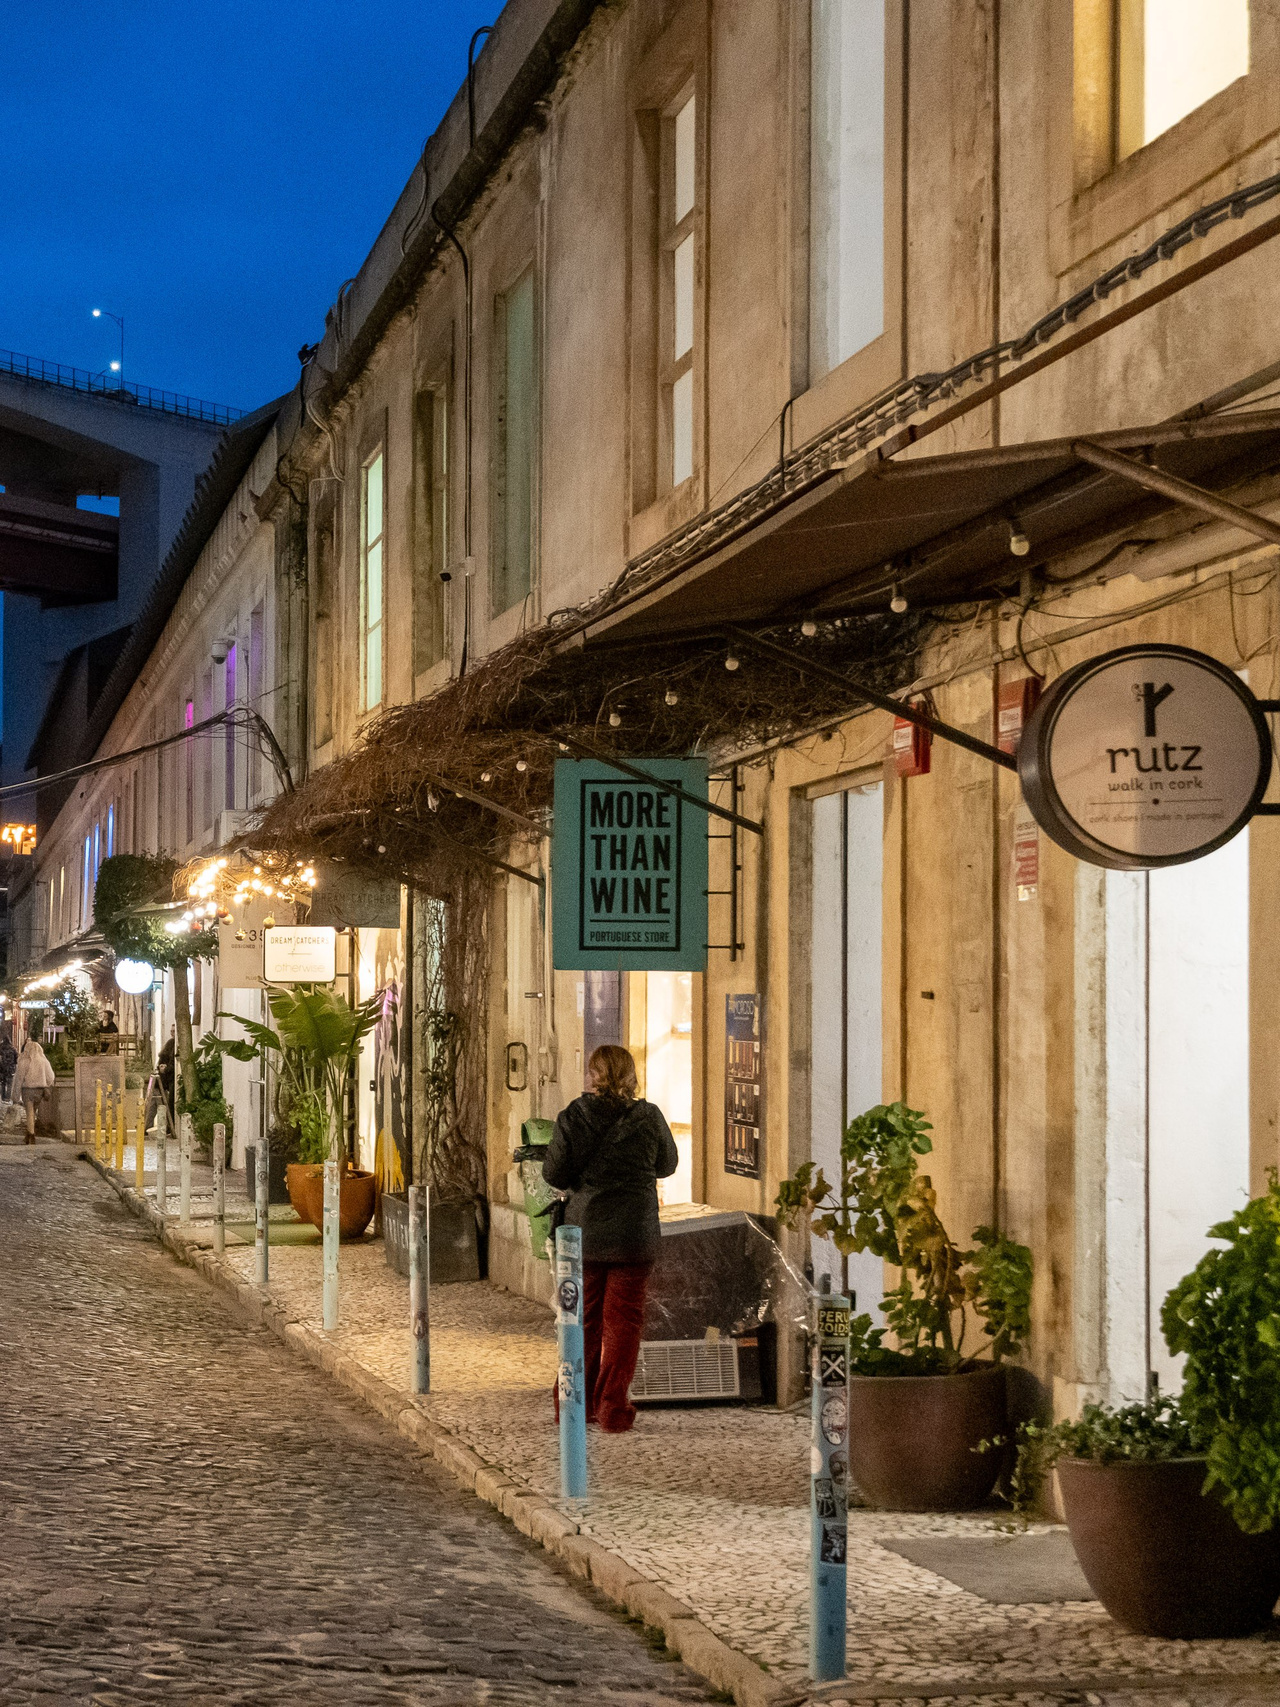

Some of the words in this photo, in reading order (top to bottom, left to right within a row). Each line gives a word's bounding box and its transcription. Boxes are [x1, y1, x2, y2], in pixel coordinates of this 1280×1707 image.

[1106, 742, 1203, 773] rutz
[1108, 777, 1143, 791] walk
[1149, 777, 1164, 790] in
[1168, 775, 1203, 790] cork
[590, 791, 670, 828] MORE
[590, 834, 670, 871] THAN
[590, 877, 670, 914] WINE
[270, 936, 293, 944] DREAM
[296, 936, 330, 944] CATCHERS
[590, 931, 642, 943] PORTUGUESE
[644, 932, 670, 943] STORE
[275, 963, 326, 973] otherwise
